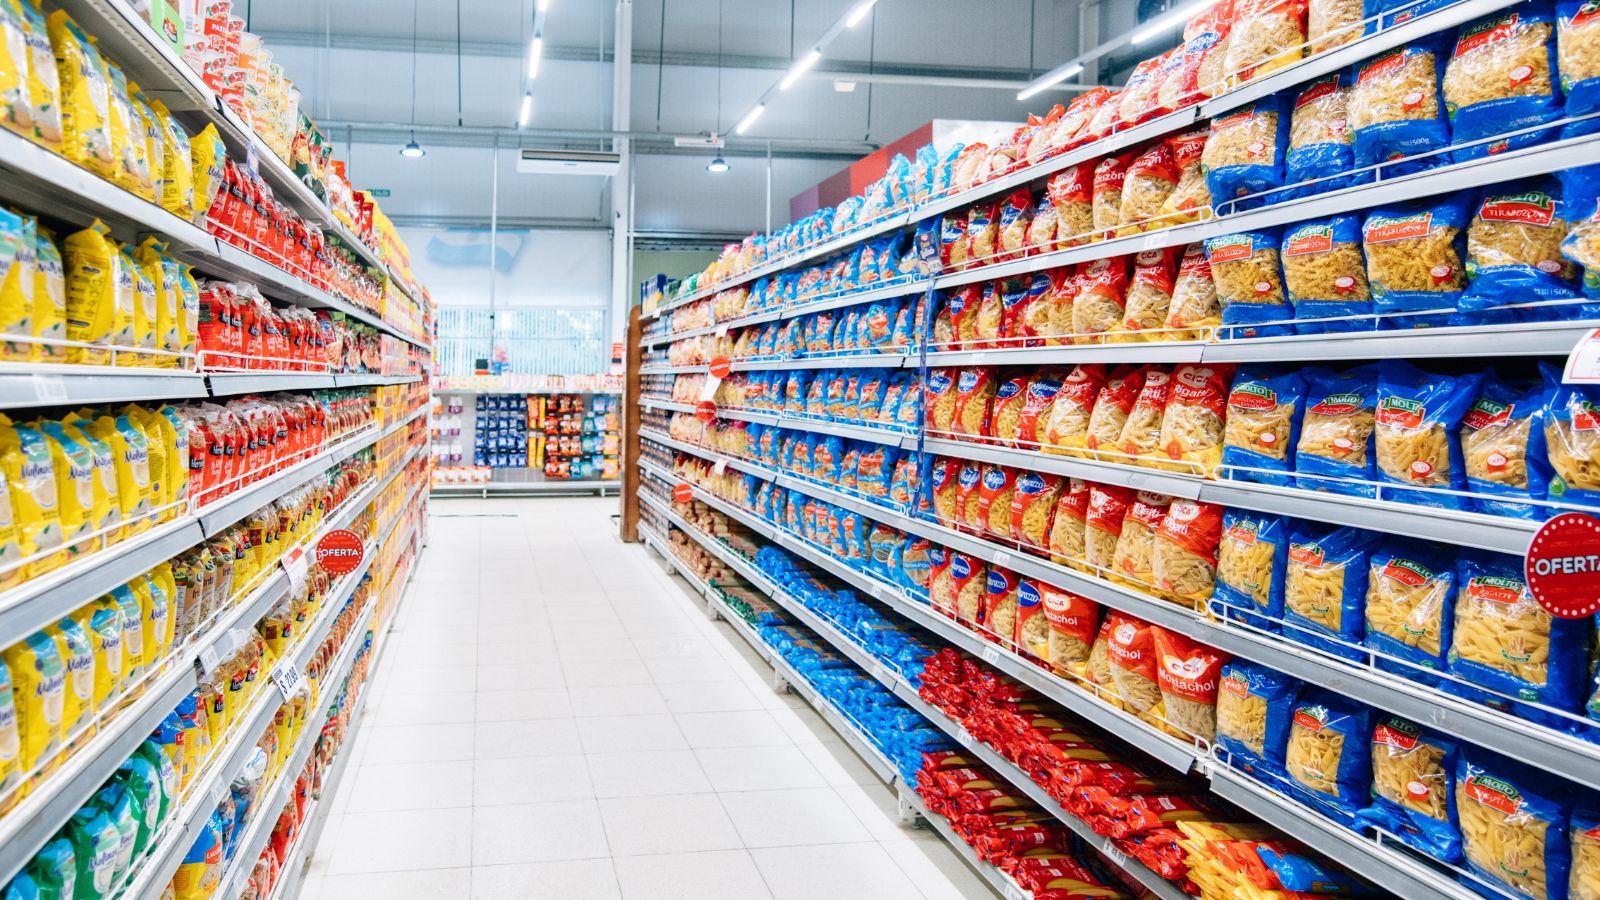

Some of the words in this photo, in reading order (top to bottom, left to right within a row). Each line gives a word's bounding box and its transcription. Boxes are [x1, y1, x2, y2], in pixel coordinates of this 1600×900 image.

[1141, 251, 1157, 259] CICA
[321, 548, 359, 558] OFERTA
[1485, 576, 1520, 588] MOLTO
[1160, 668, 1215, 693] Mostachol
[1482, 777, 1514, 796] MOLTO
